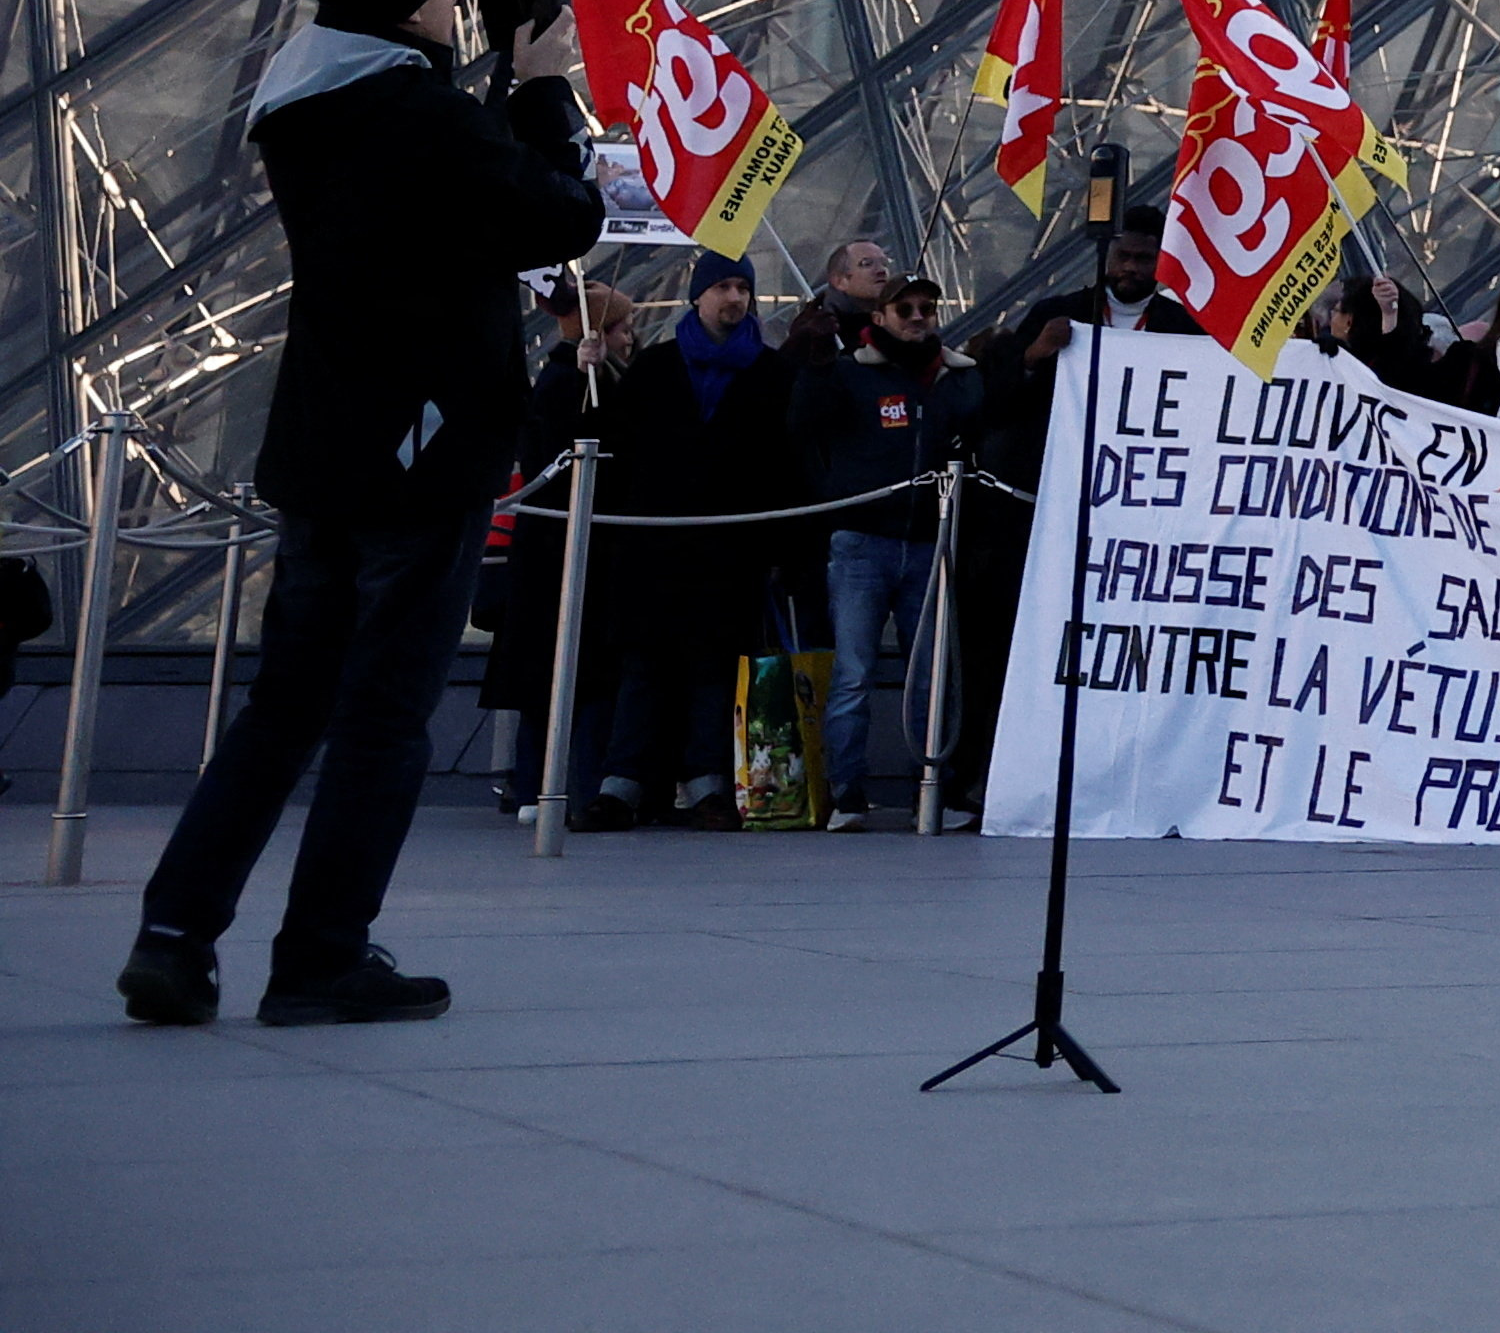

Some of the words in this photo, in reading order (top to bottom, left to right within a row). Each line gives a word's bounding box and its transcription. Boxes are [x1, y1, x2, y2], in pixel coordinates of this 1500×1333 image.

[880, 401, 907, 420] cgt
[1116, 367, 1187, 437] LE
[1217, 376, 1407, 465] LOUVRE
[1416, 423, 1489, 486] EN
[1090, 444, 1189, 507] DES
[1210, 455, 1457, 539] CONDITIONS
[1449, 493, 1497, 556] DE
[1086, 536, 1273, 610] HAUSSE
[1291, 555, 1384, 624] DES
[1054, 622, 1256, 699] CONTRE
[1268, 637, 1329, 716] LA
[1218, 731, 1284, 814] ET
[1306, 744, 1371, 829] LE
